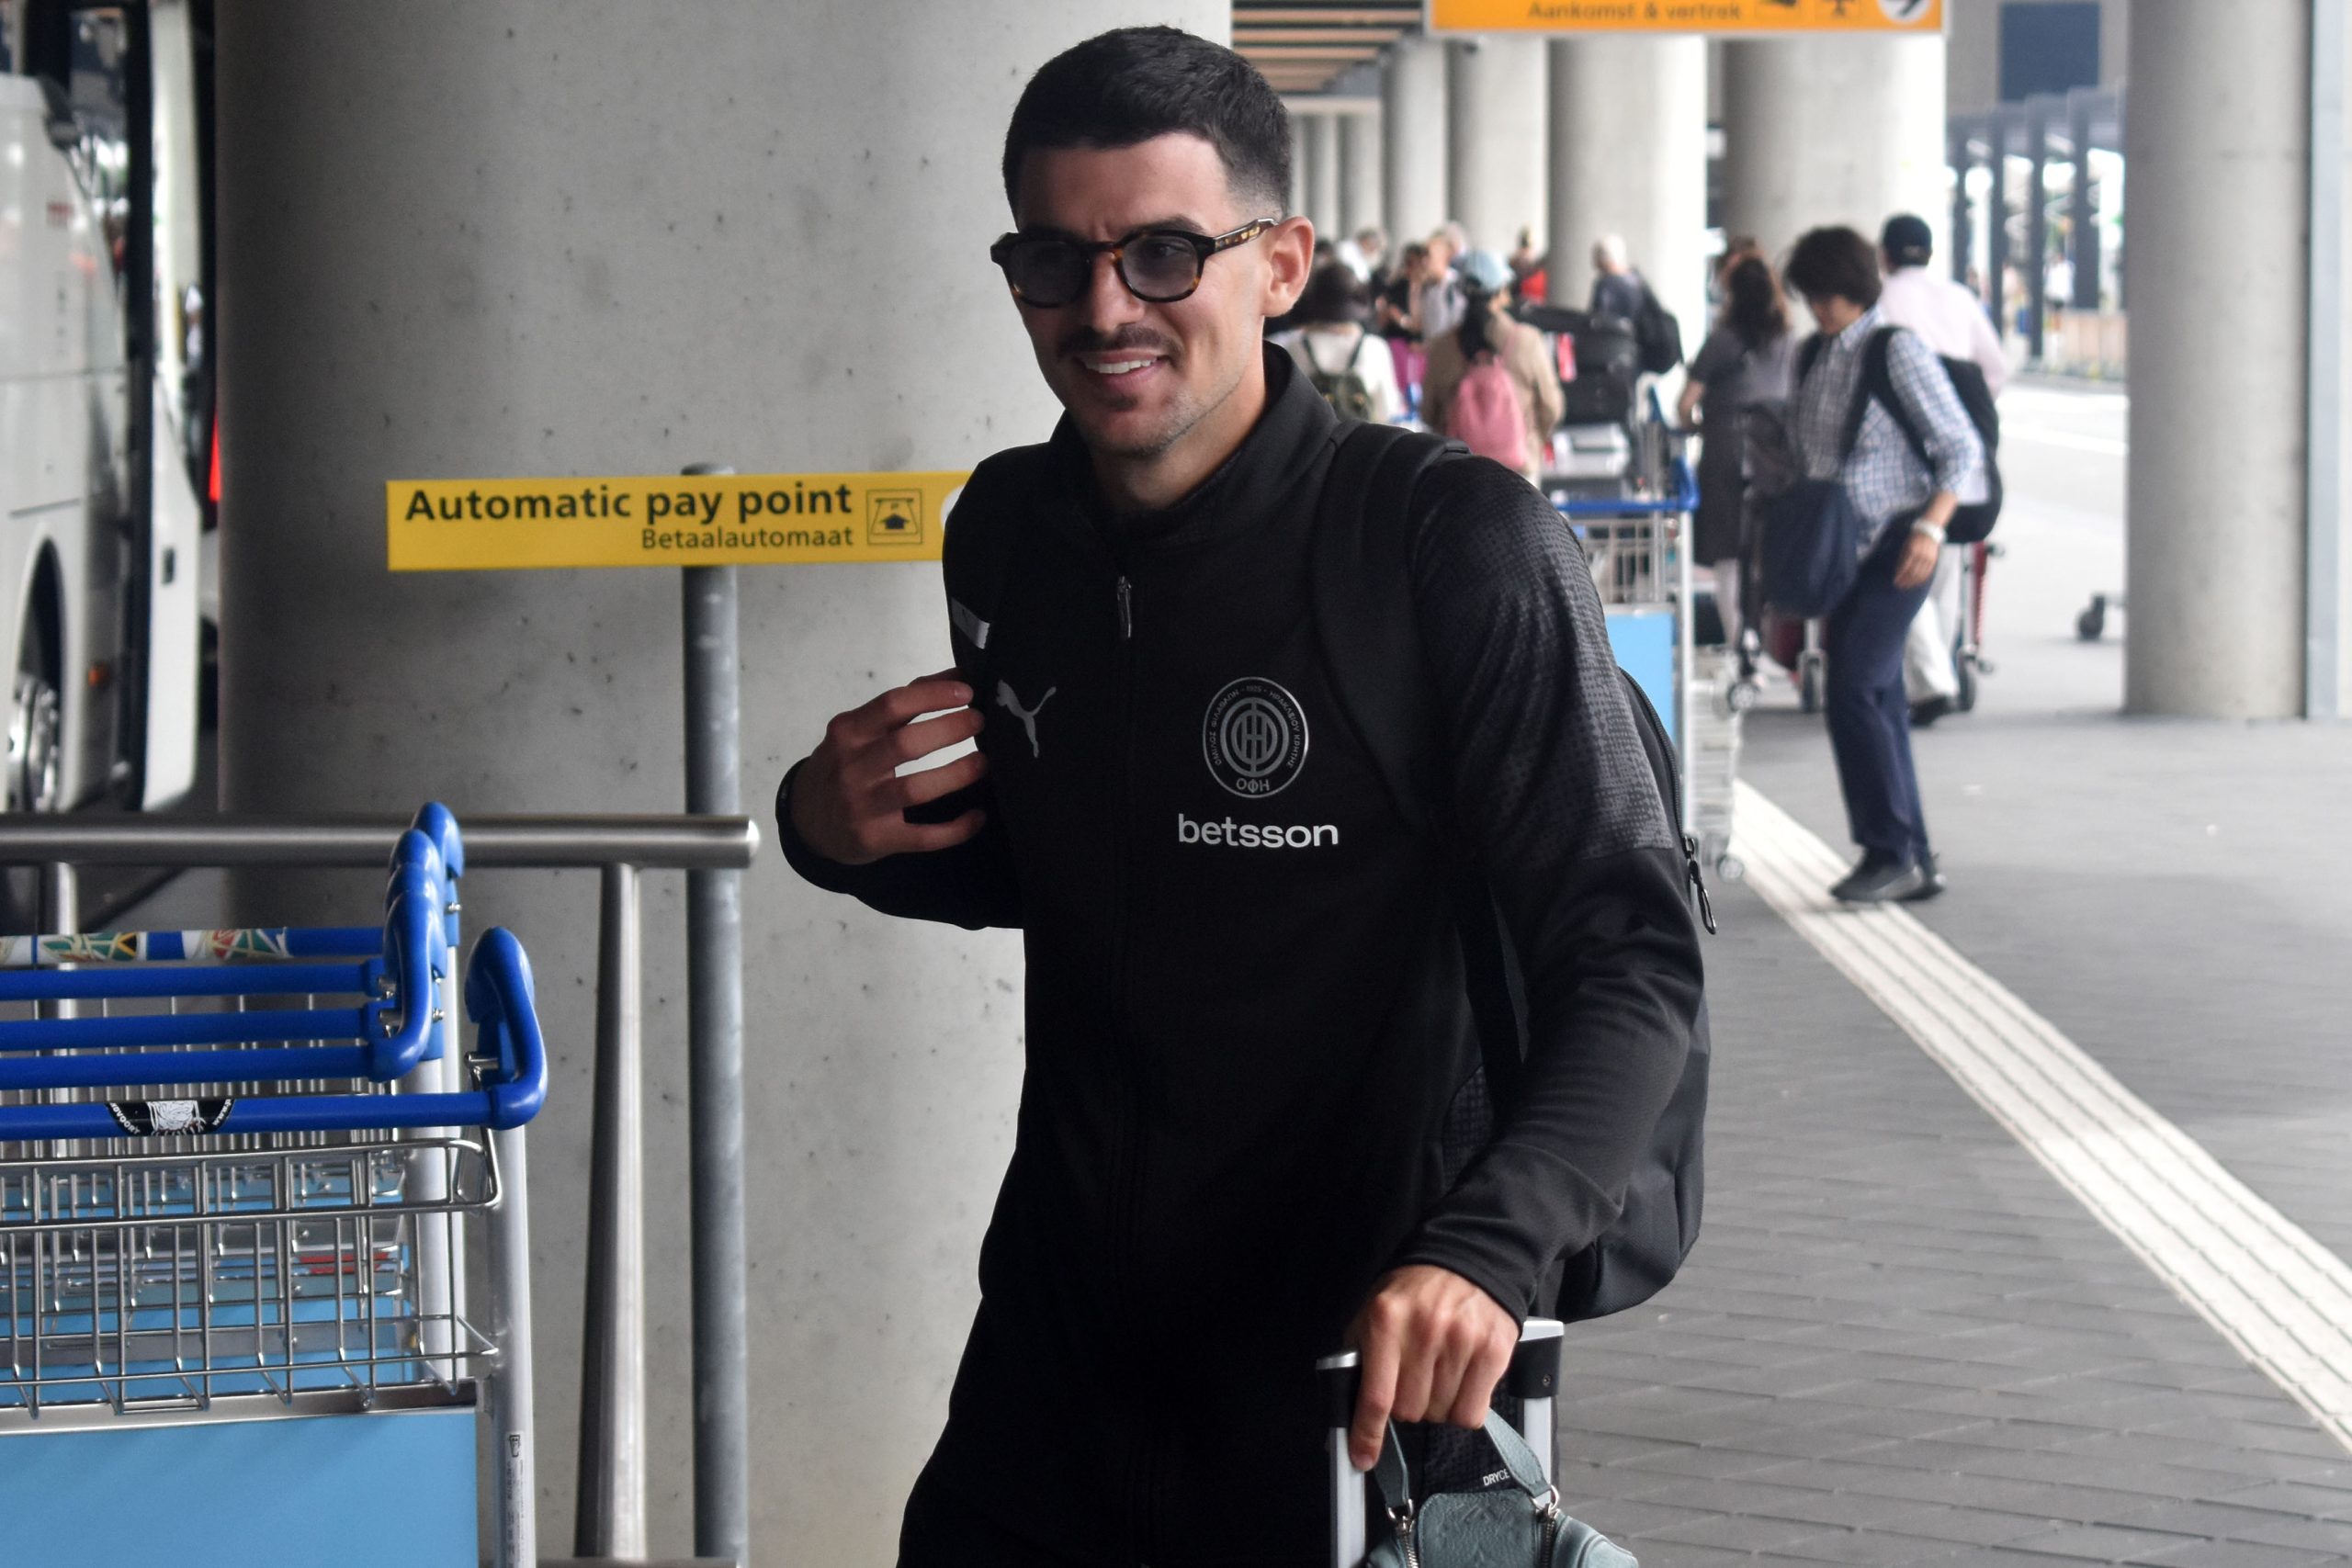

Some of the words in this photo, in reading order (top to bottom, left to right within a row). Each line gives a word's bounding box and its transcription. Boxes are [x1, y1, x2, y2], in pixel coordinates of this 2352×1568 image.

[1529, 2, 1635, 19] Aankomst
[1644, 3, 1657, 19] &
[1667, 2, 1741, 19] vertrek
[405, 485, 632, 521] Automatic
[647, 491, 724, 525] pay
[738, 481, 853, 516] point
[641, 525, 854, 549] Betaalautomaat
[1178, 813, 1339, 849] betsson
